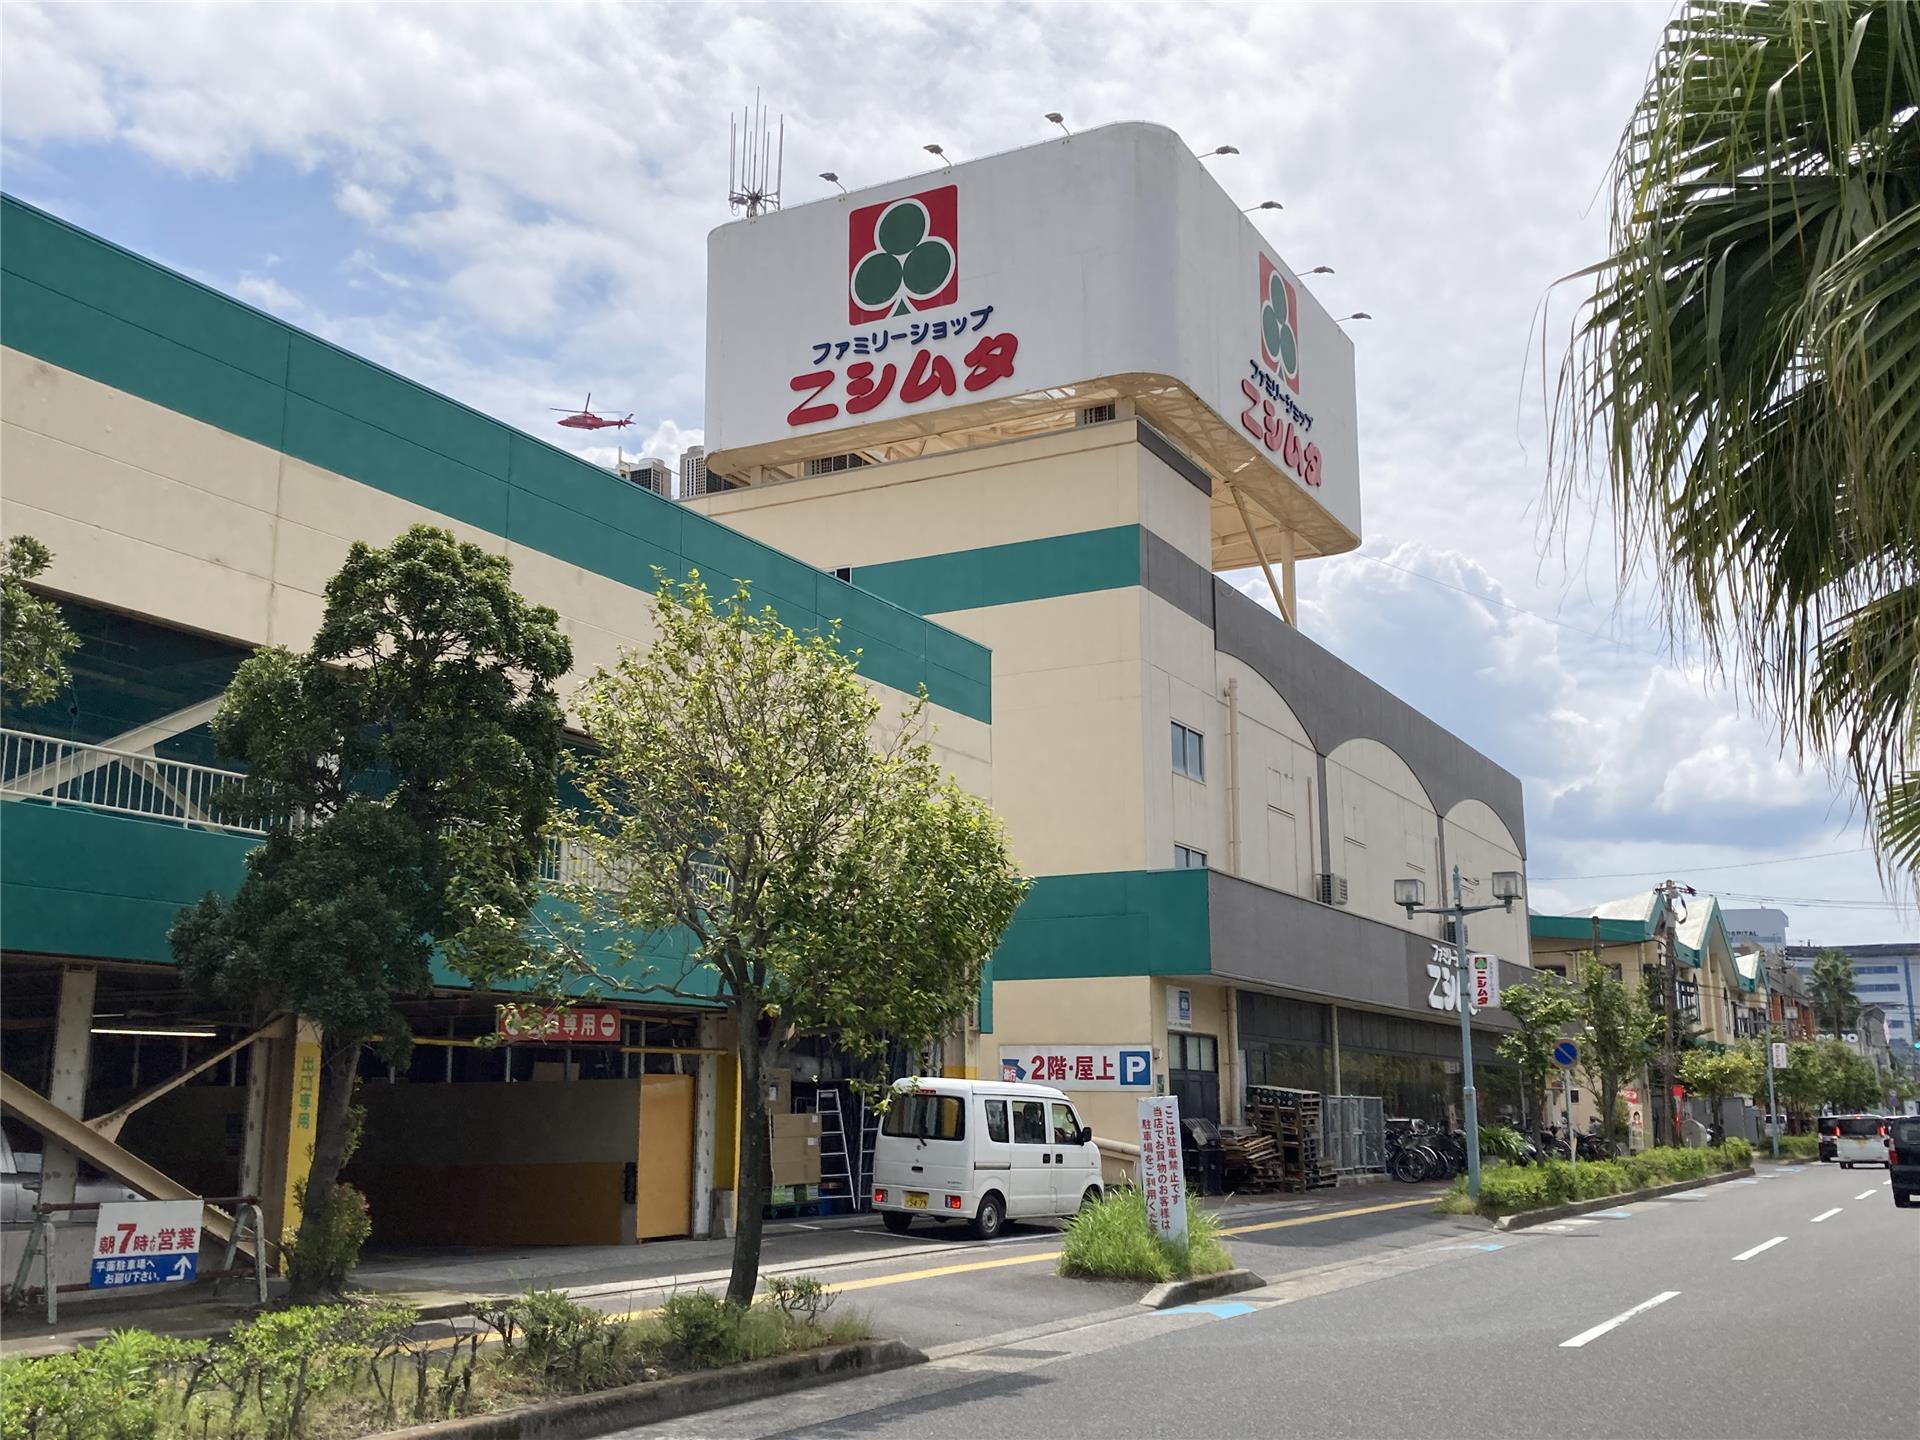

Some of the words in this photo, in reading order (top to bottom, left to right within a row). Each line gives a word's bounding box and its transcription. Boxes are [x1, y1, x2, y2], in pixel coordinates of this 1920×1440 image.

[813, 305, 994, 365] ファミリーショップ
[787, 332, 1019, 427] ニシムタ
[1249, 359, 1314, 432] ファミリーショップ
[1241, 378, 1322, 487] ニシムタ
[1476, 970, 1488, 1006] ニシムタ
[297, 1056, 315, 1129] 出口専用
[1126, 1056, 1146, 1082] P
[1153, 1106, 1171, 1230] 当店でお買物のお客様は
[1165, 1105, 1181, 1205] ここは駐車禁止です
[95, 1258, 156, 1273] 平面駐車場へ
